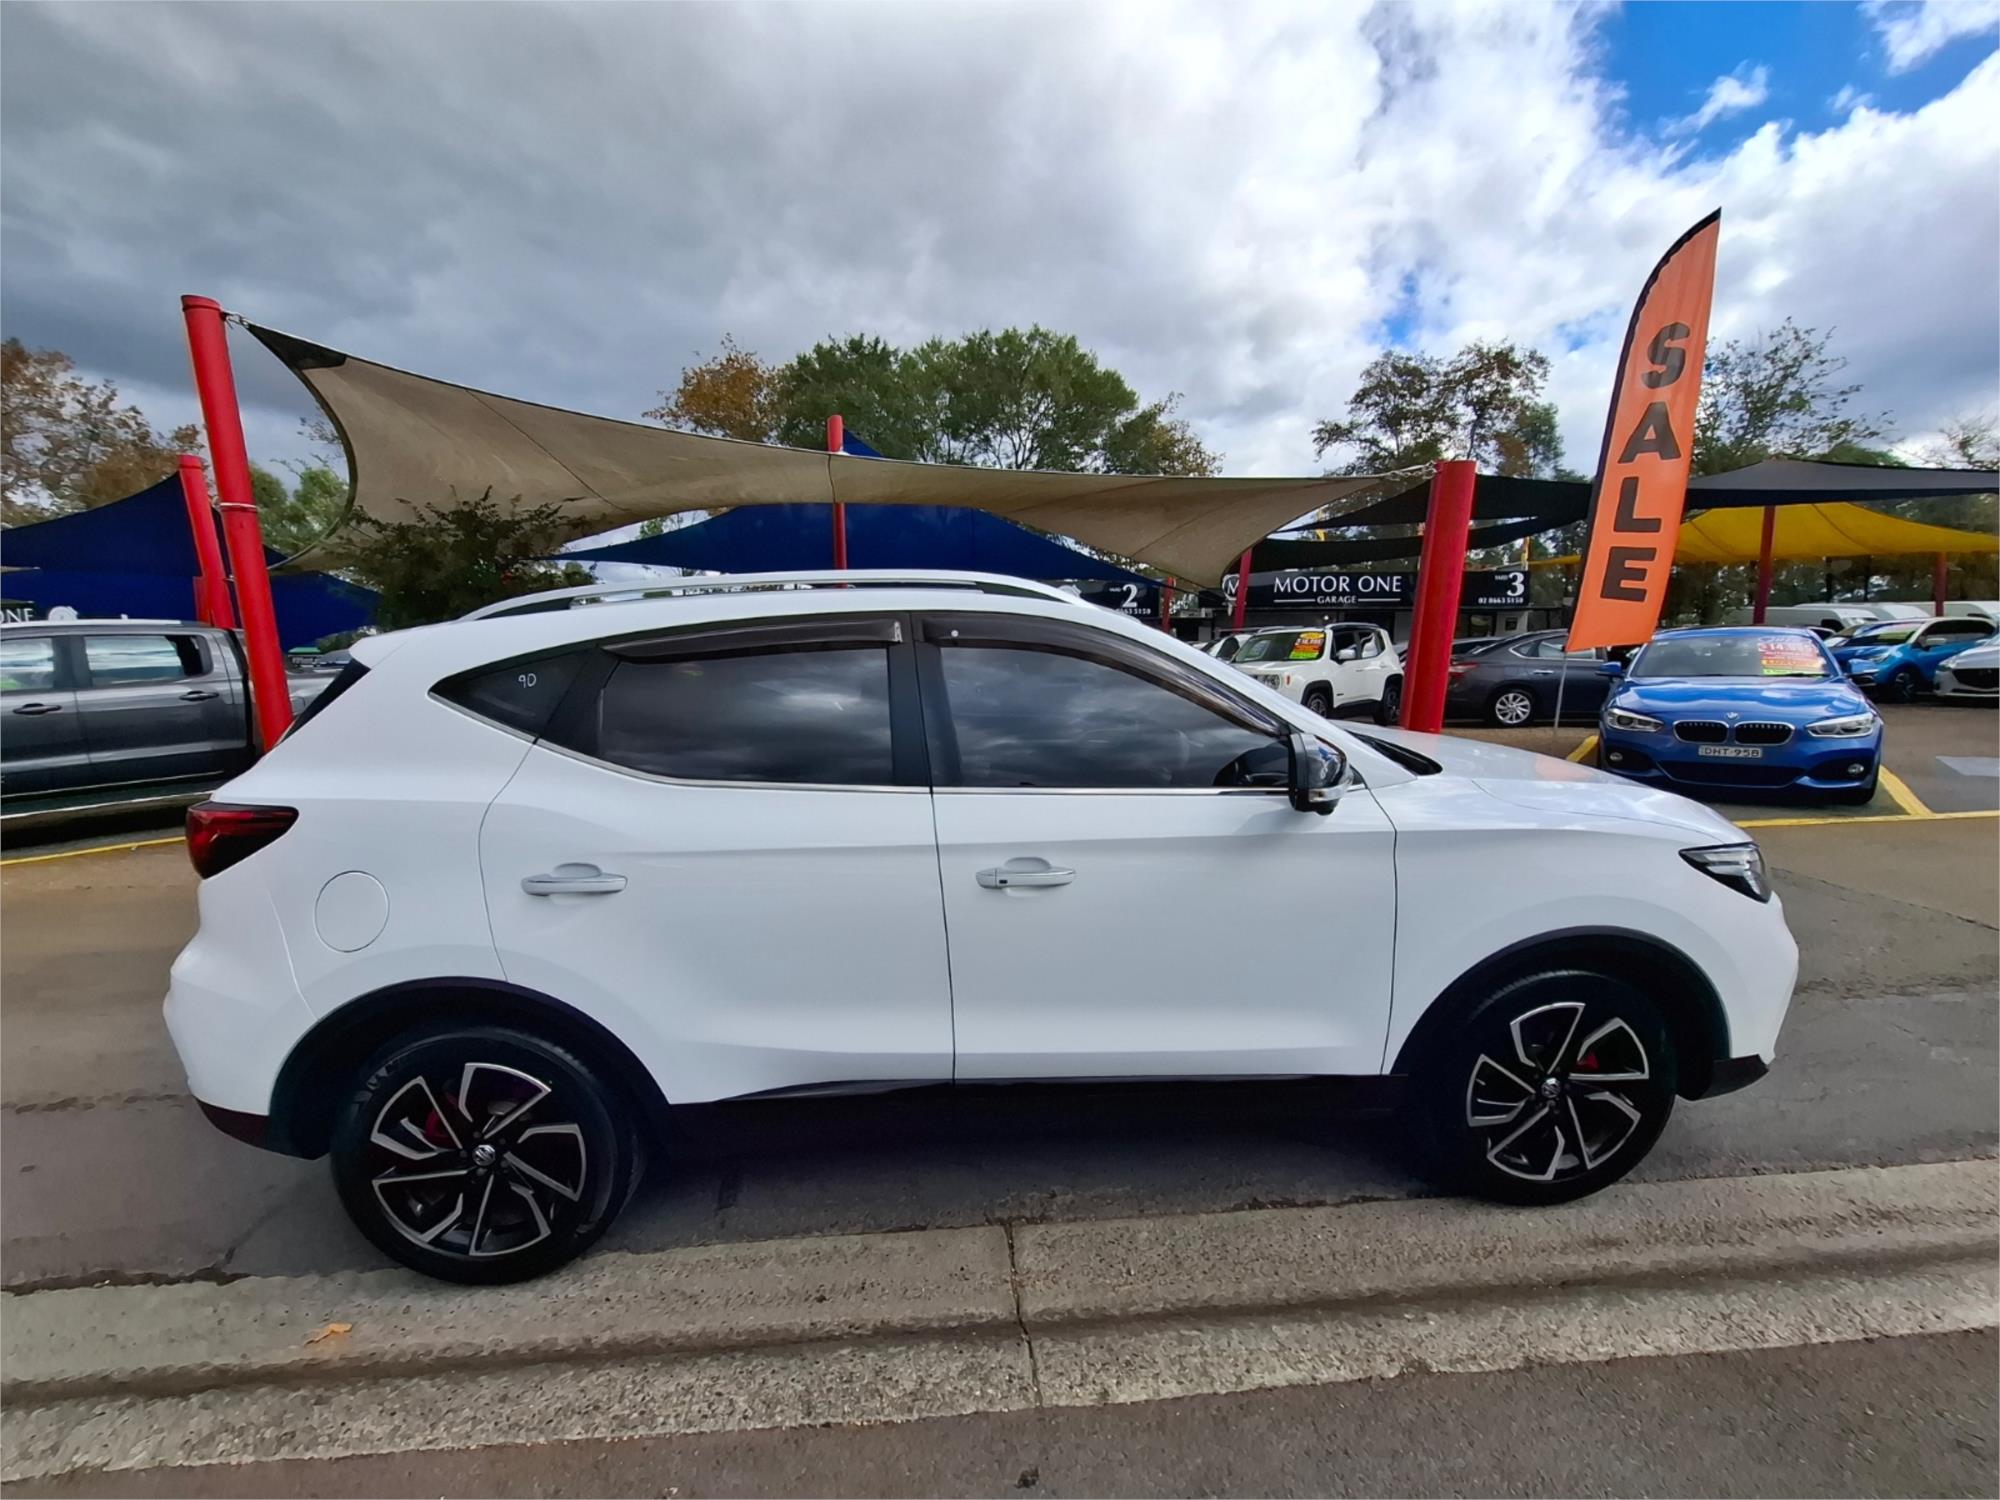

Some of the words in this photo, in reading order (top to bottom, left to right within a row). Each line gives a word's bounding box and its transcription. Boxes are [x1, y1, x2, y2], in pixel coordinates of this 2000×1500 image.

[1600, 321, 1690, 602] SALE
[1273, 576, 1350, 593] MOTOR
[1358, 575, 1402, 592] ONE
[1507, 571, 1525, 596] 3
[1122, 583, 1138, 608] 2
[1317, 595, 1357, 604] GARAGE
[1, 607, 33, 622] NE
[518, 673, 537, 688] 90
